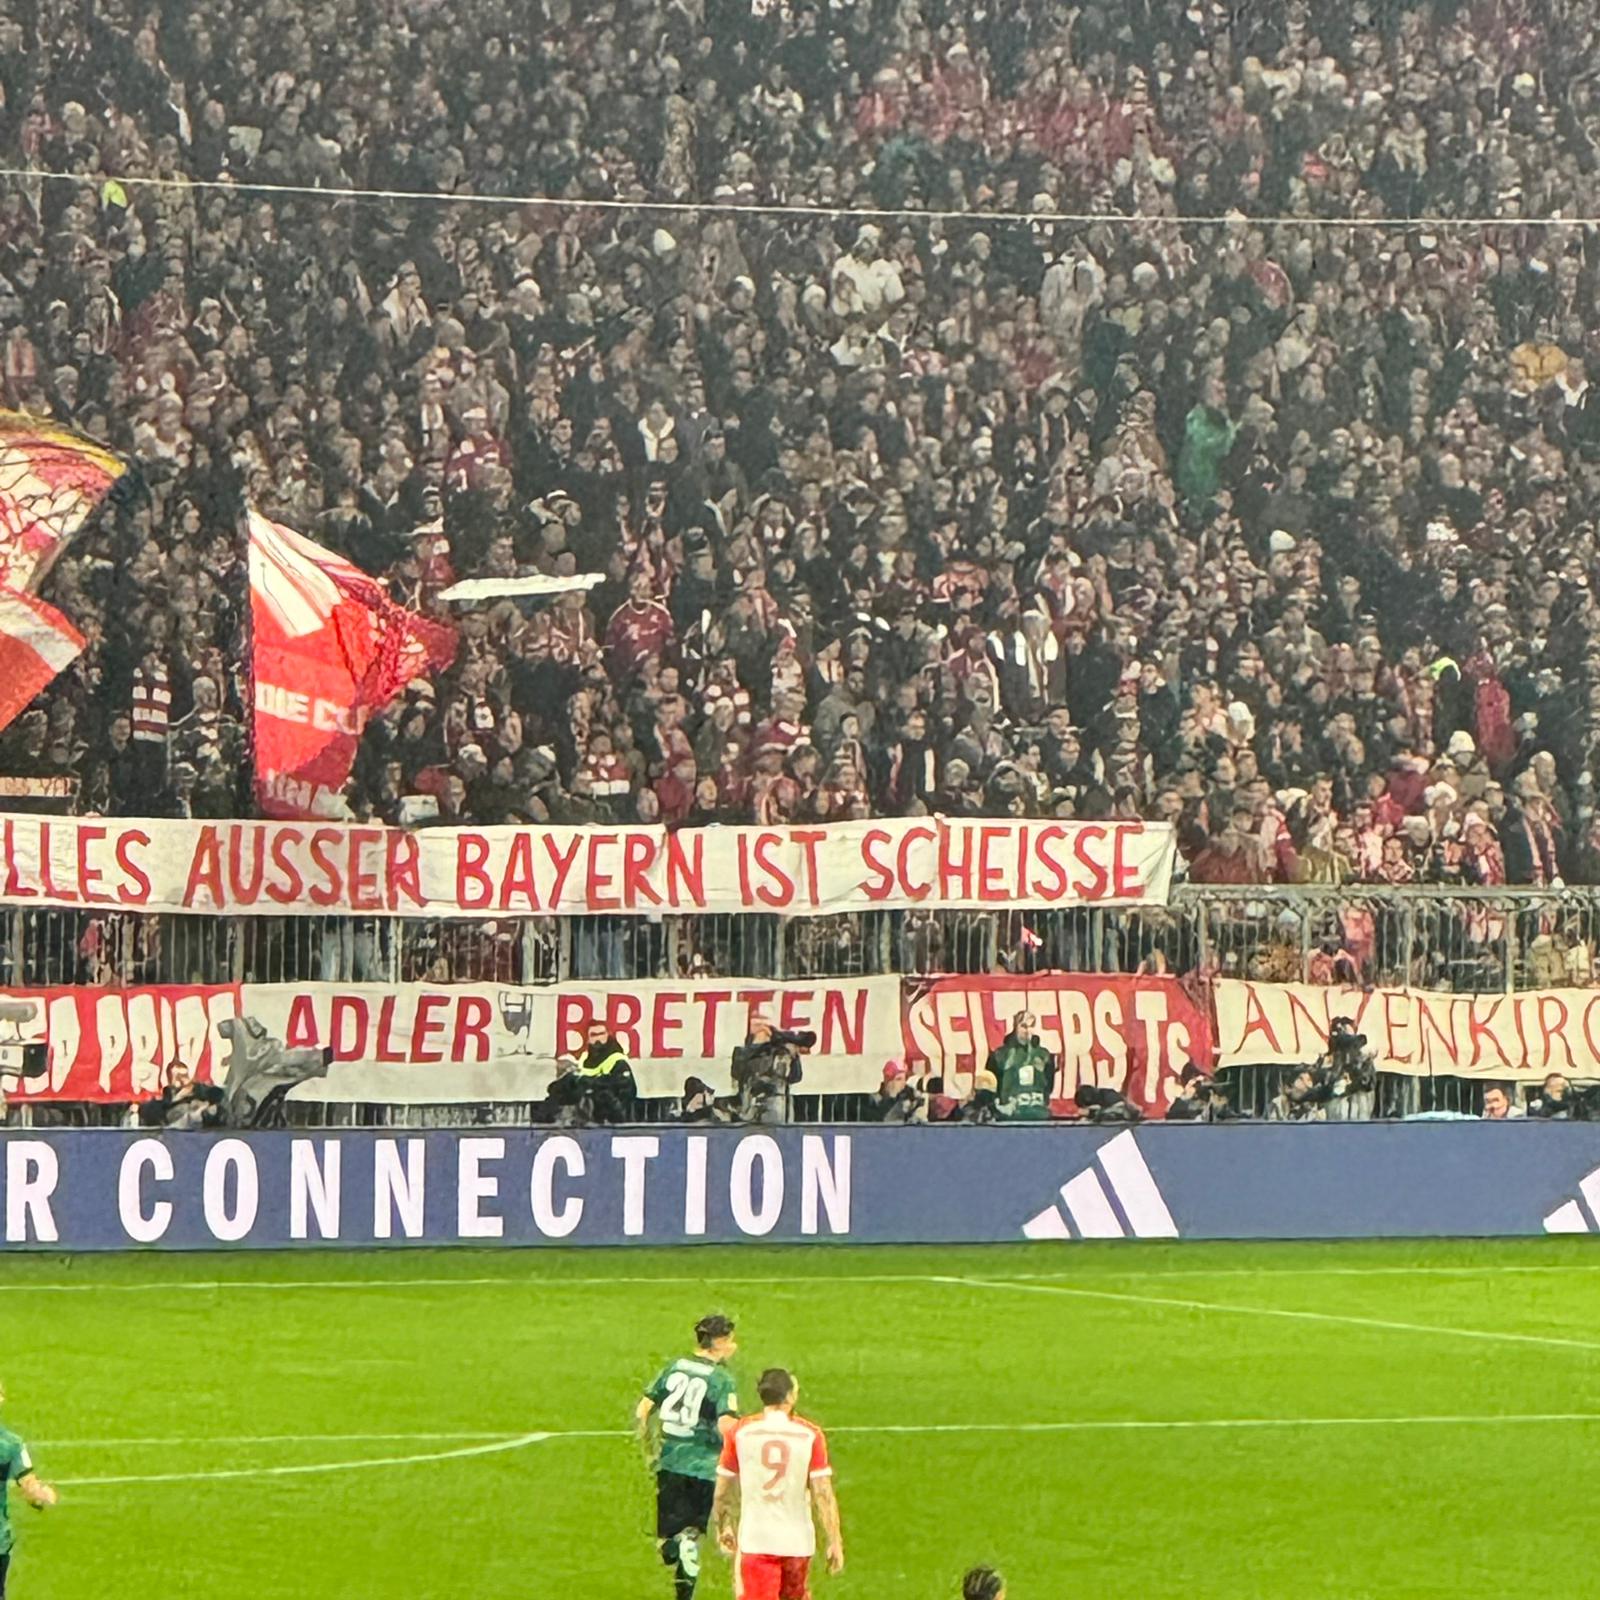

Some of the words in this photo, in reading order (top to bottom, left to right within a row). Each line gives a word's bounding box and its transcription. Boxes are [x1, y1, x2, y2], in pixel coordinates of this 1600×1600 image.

[3, 818, 152, 905] LLES
[182, 824, 430, 909] AUSSER
[456, 830, 707, 911] BAYERN
[737, 830, 828, 907] IST
[857, 824, 1144, 902] SCHEISSE
[286, 994, 493, 1063] ADLER
[555, 989, 869, 1059] BRETTEN
[5, 1140, 59, 1241] R
[118, 1134, 852, 1241] CONNECTION
[760, 1439, 791, 1490] 9
